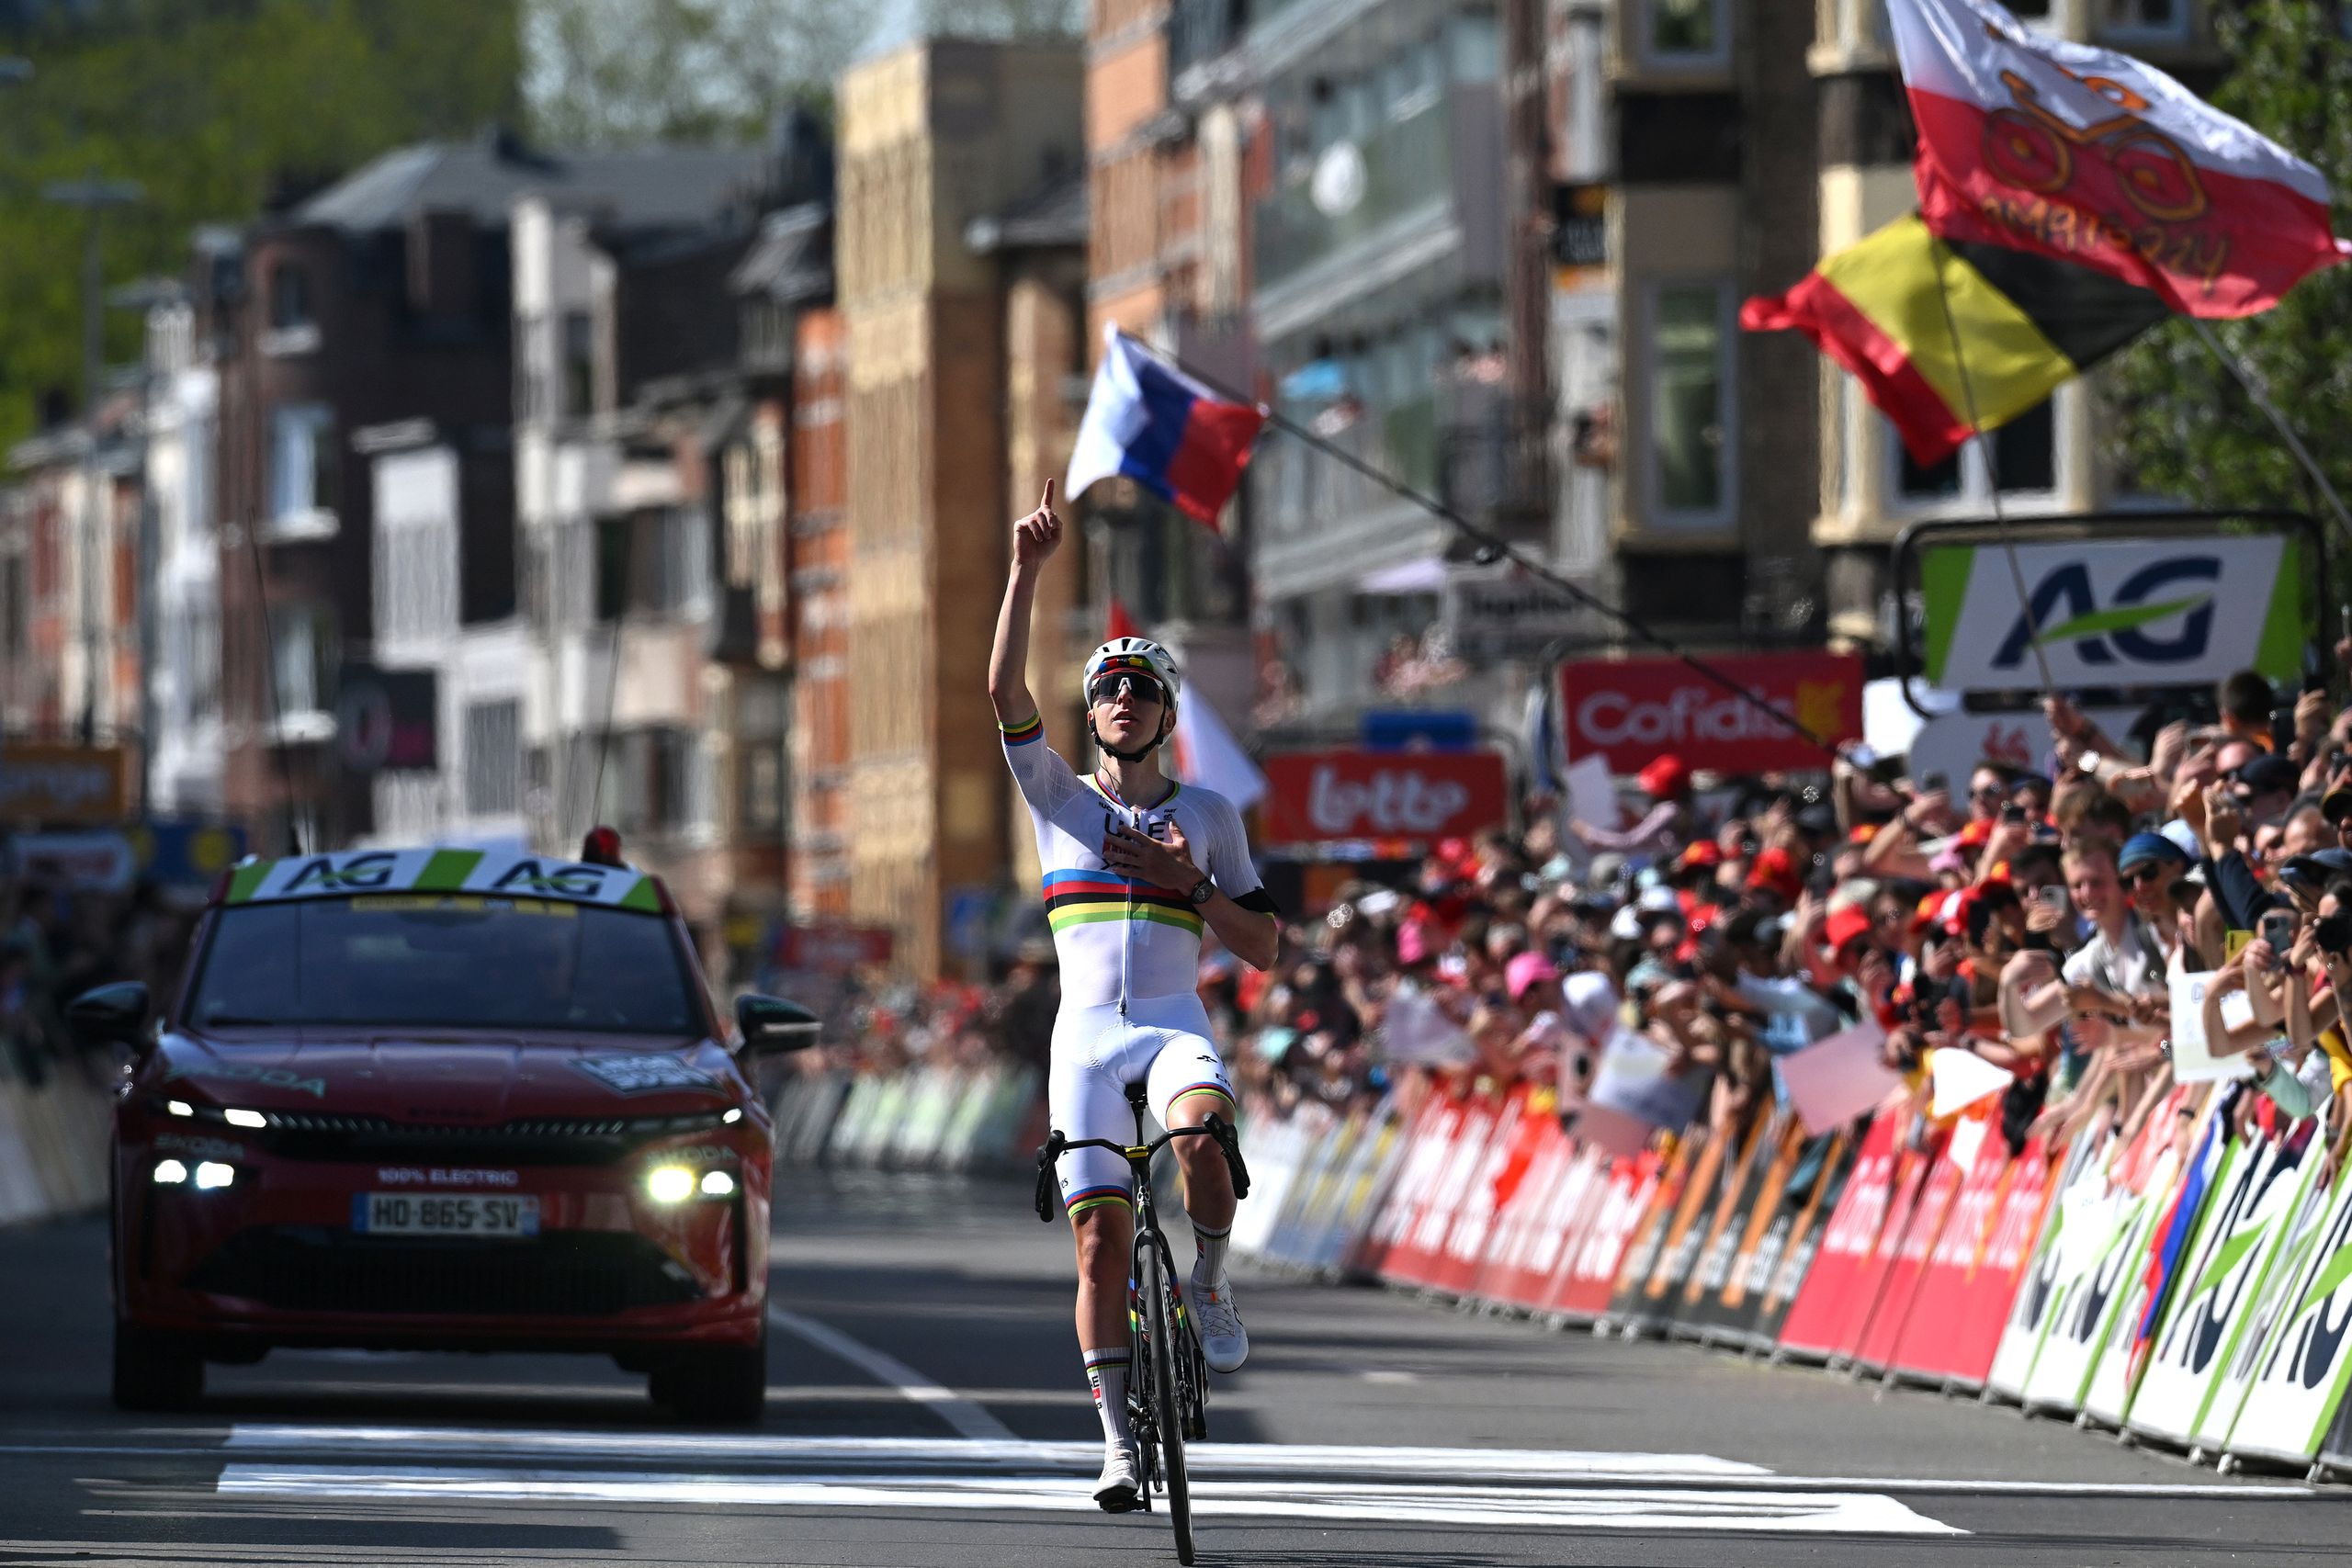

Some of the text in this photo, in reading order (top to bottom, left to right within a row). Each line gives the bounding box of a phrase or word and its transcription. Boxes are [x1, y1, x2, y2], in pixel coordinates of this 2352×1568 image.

[1991, 557, 2223, 669] AG
[1577, 685, 1793, 746] Cofidis
[1104, 813, 1167, 841] UE
[282, 852, 399, 893] AG
[492, 860, 606, 897] AG
[378, 1168, 519, 1187] 100% ELECTRIC
